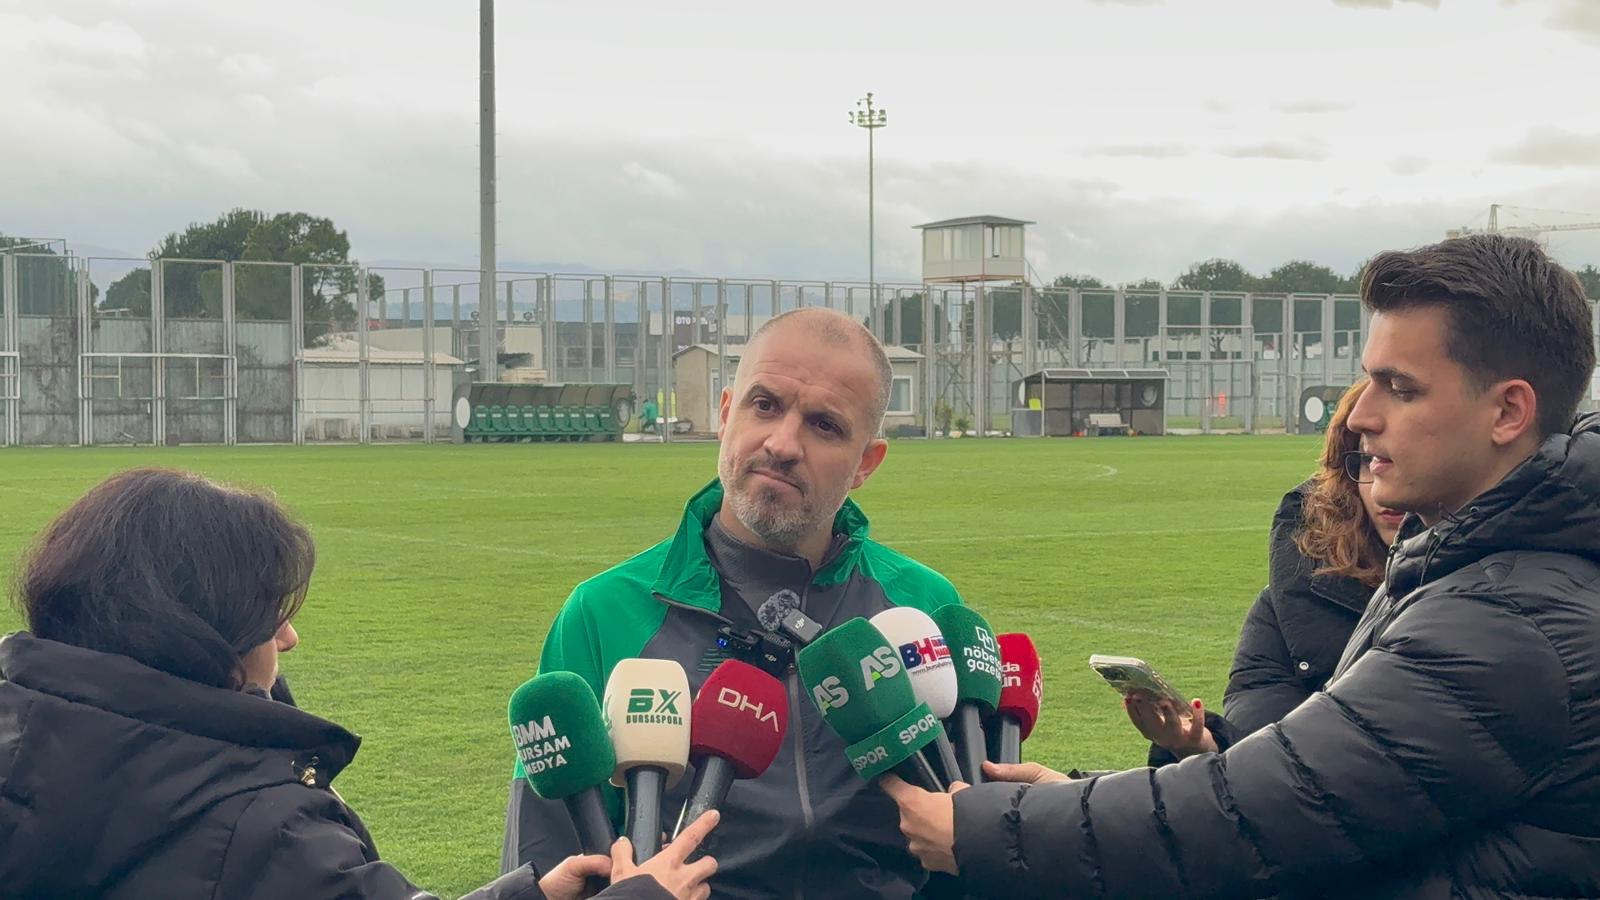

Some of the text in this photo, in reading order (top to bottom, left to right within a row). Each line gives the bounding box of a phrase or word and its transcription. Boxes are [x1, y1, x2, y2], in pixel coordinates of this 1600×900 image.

[860, 646, 901, 691] AS
[898, 638, 938, 670] BH
[627, 688, 683, 715] BX
[718, 687, 780, 732] DHA
[812, 675, 850, 716] AS
[512, 715, 556, 747] BMM
[898, 713, 938, 745] SPOR
[519, 735, 571, 761] URSAM
[853, 746, 889, 771] SPOR
[524, 754, 568, 775] MEDYA
